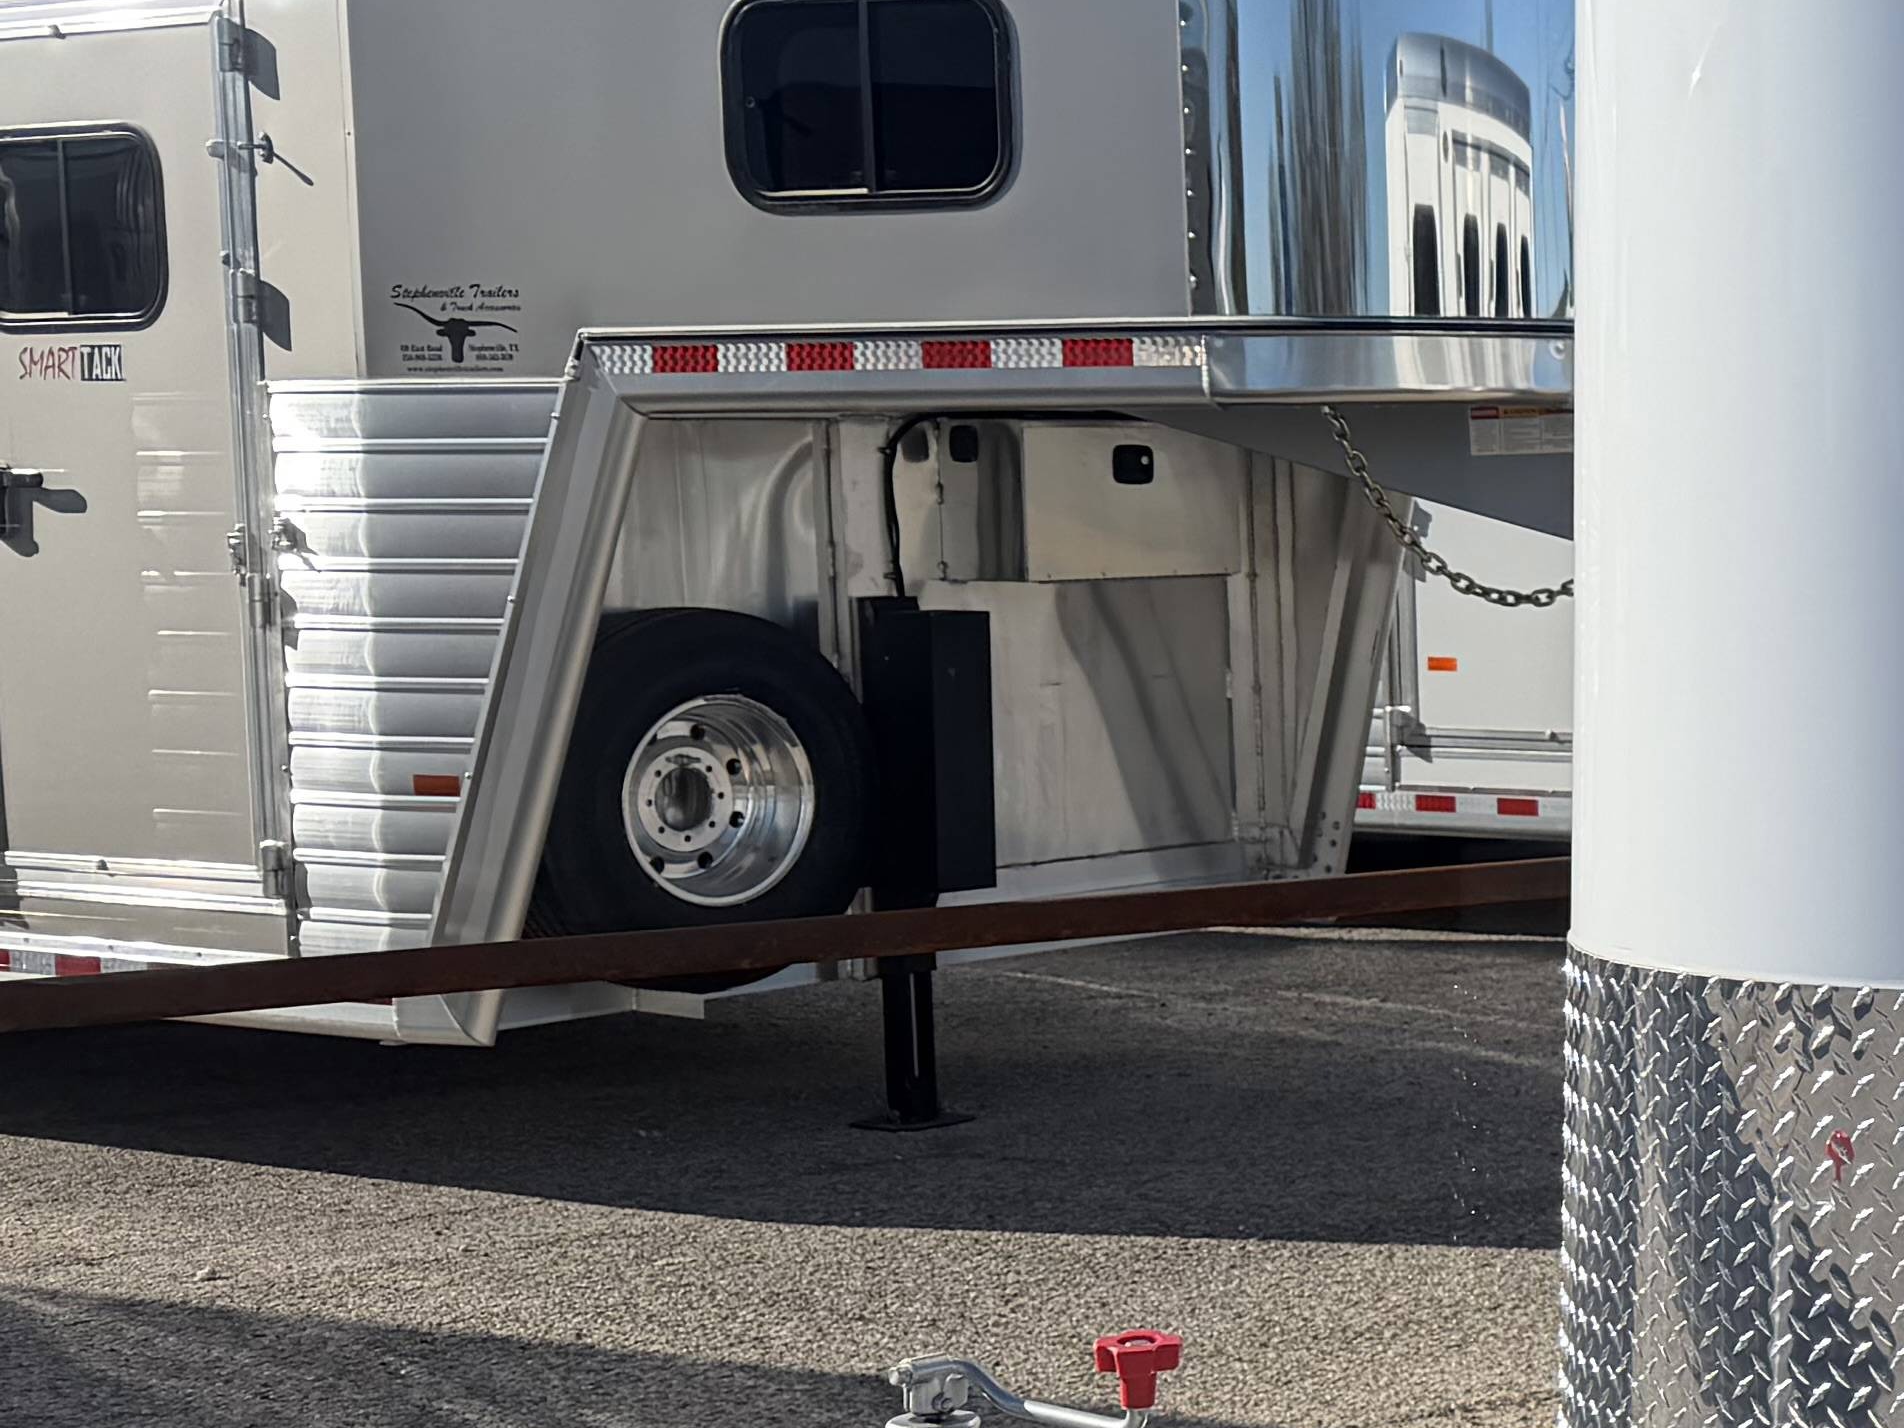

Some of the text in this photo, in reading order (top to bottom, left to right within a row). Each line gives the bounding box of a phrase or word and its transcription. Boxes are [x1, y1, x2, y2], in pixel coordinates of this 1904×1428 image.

[469, 283, 519, 298] Trailers
[19, 346, 123, 380] SMART TACK
